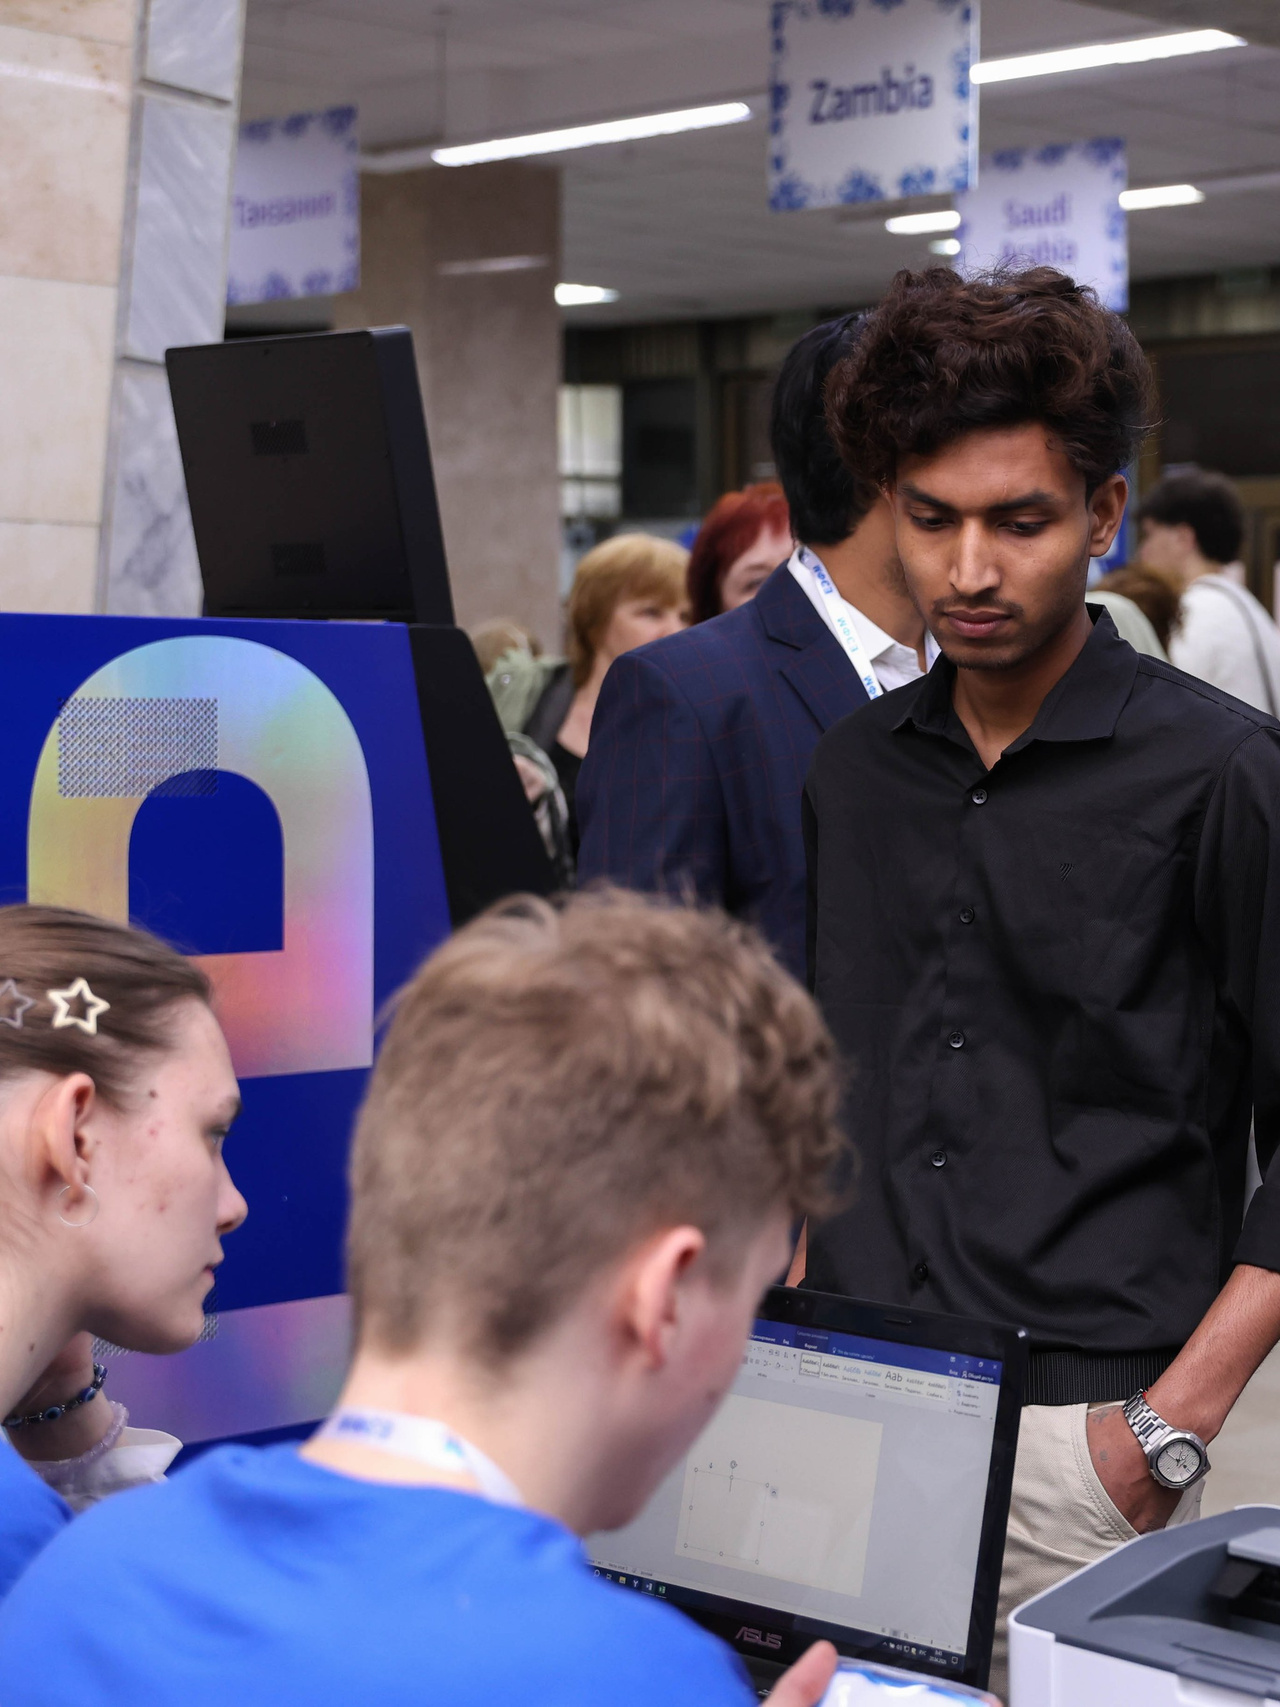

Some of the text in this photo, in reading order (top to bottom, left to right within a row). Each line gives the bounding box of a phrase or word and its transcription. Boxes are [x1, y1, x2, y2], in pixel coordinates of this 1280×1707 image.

[809, 63, 934, 125] Zambia
[1004, 190, 1071, 230] Saudi
[735, 1626, 782, 1650] ASUS
